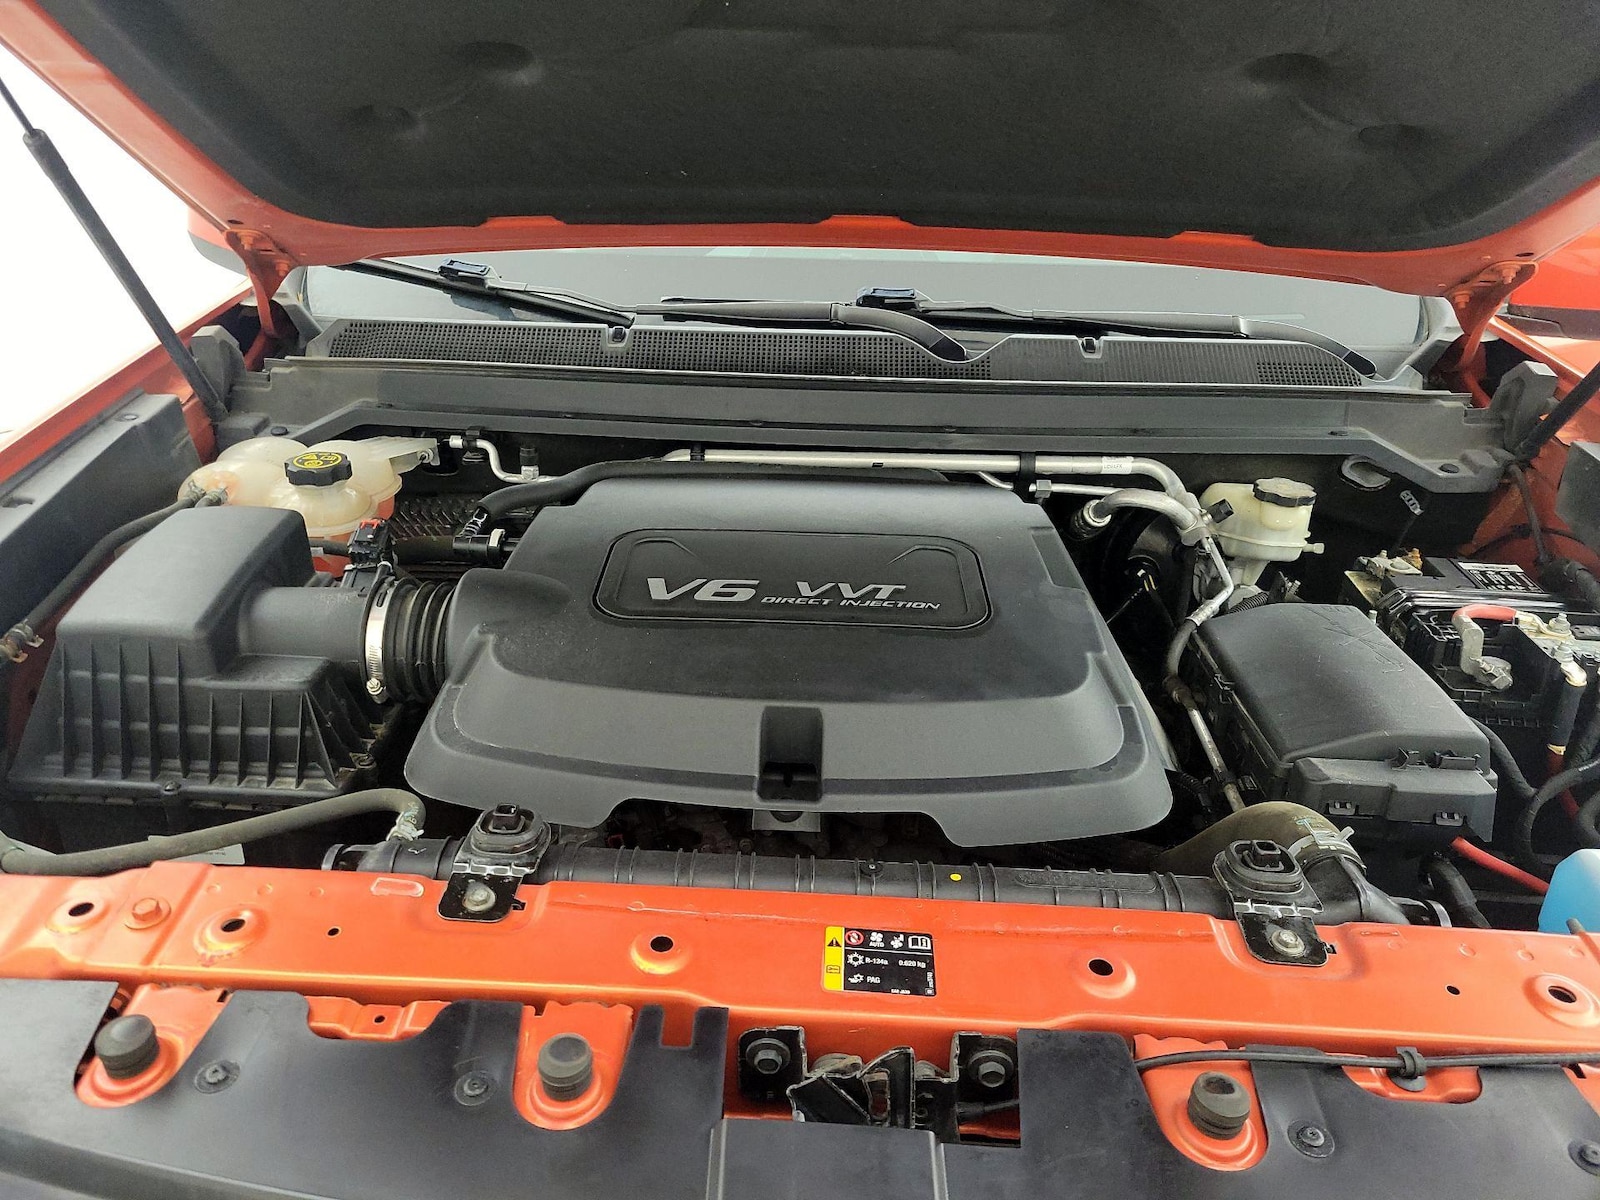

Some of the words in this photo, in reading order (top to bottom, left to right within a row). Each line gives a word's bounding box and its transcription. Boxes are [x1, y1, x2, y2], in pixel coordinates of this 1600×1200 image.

[647, 577, 760, 602] V6
[796, 581, 907, 599] VVT
[761, 596, 834, 606] DIRECT
[840, 599, 941, 610] INJECTION
[866, 976, 881, 984] PAG
